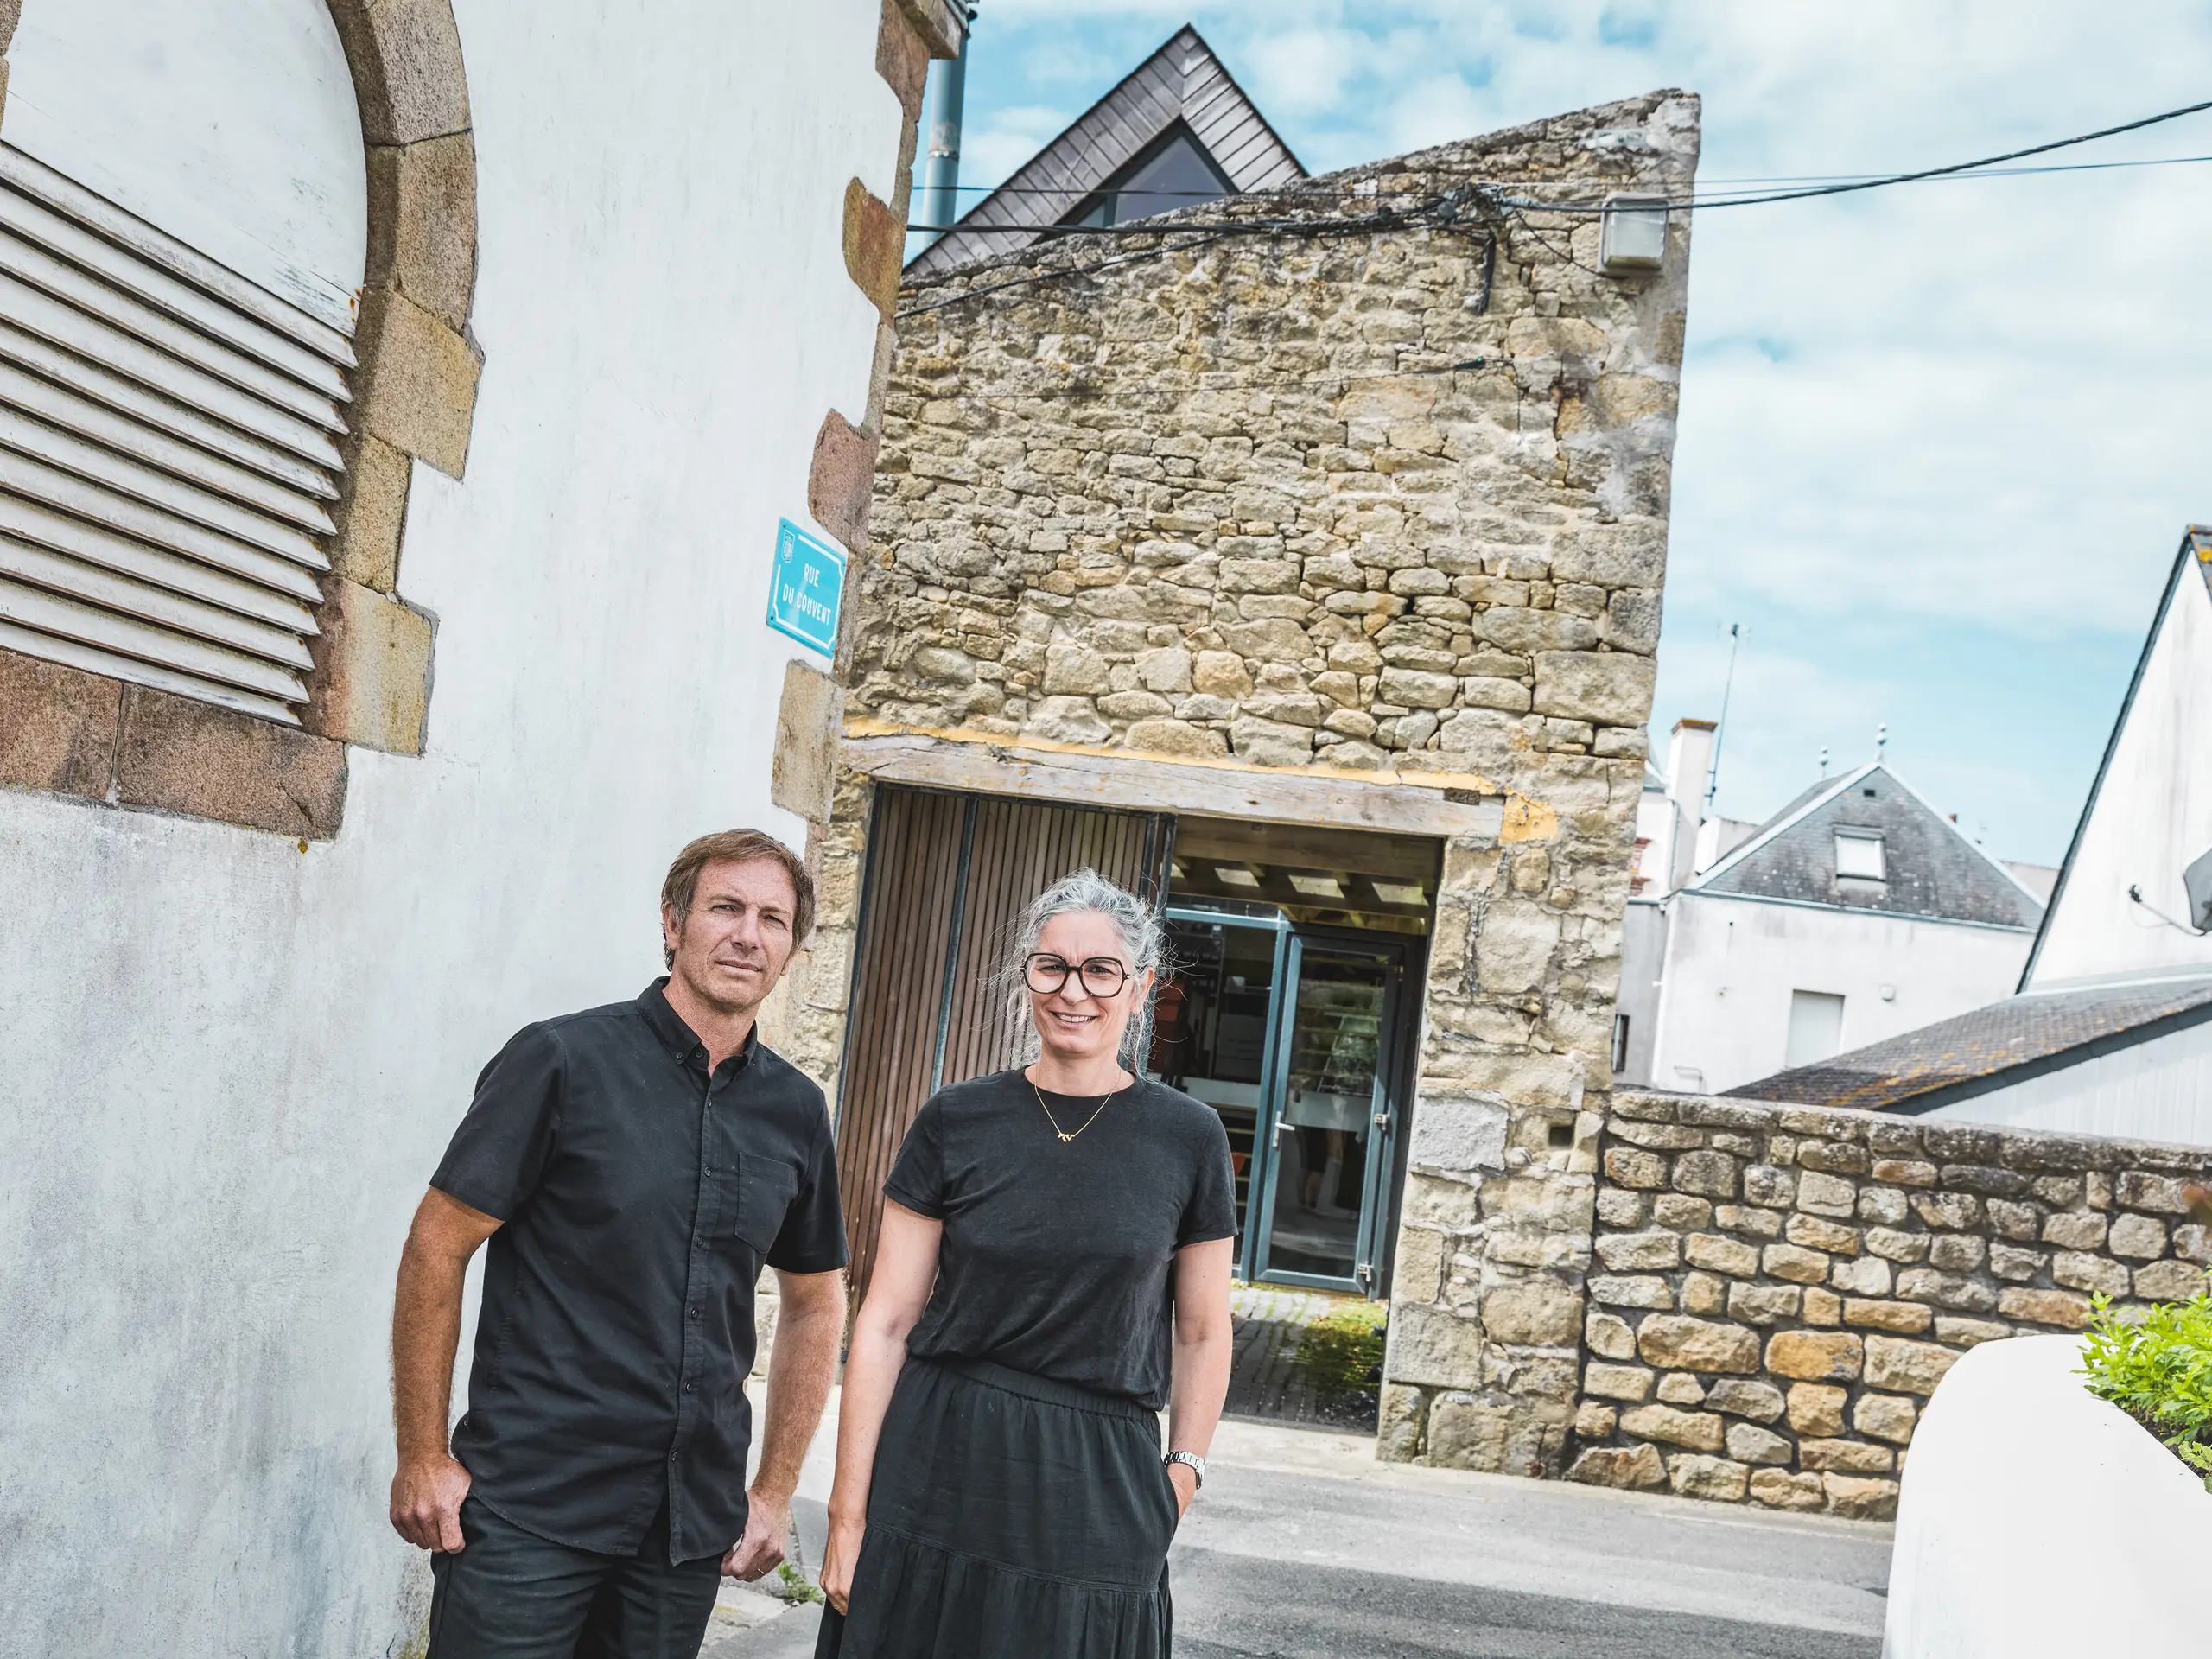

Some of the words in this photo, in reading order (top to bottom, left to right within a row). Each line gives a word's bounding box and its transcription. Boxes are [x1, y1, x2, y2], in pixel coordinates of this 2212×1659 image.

[804, 563, 820, 588] RUE
[783, 582, 794, 605] DU
[797, 592, 831, 626] COUVENT
